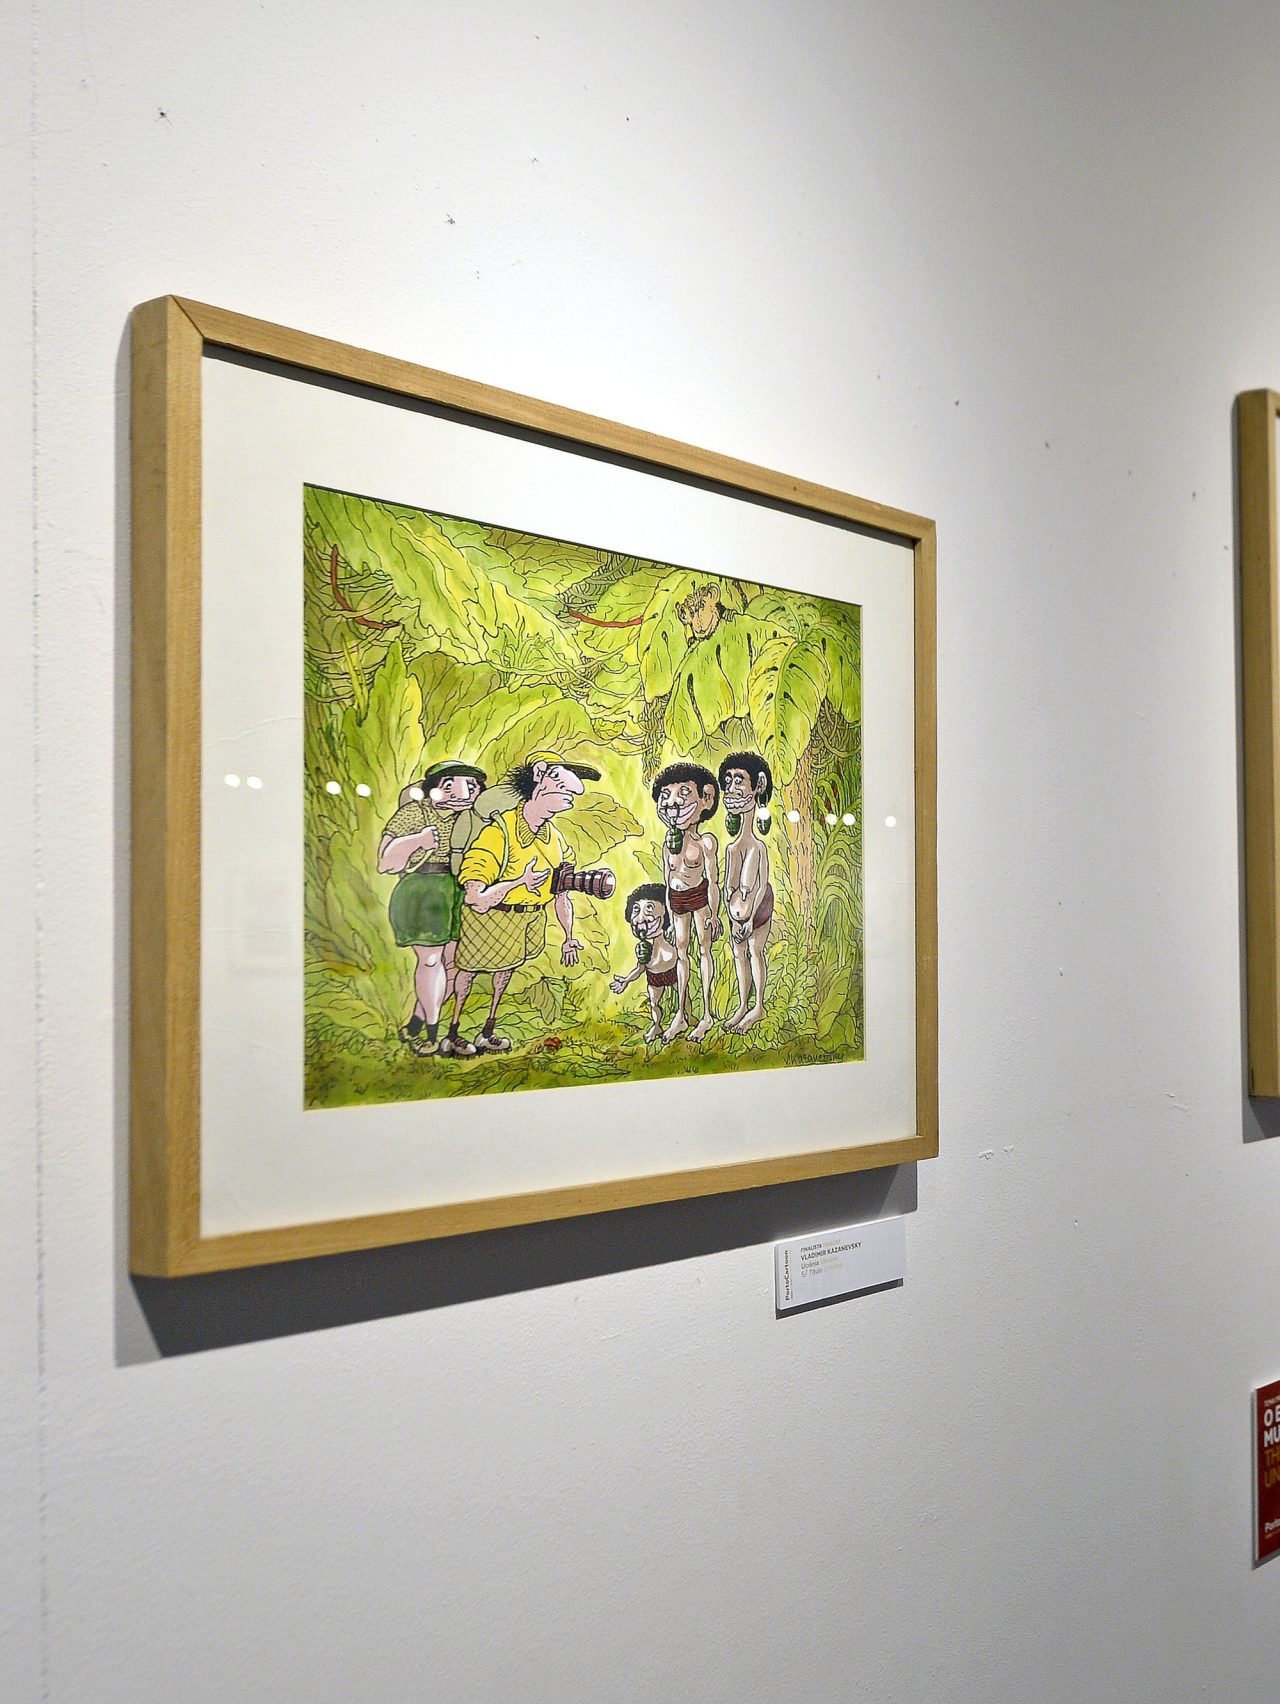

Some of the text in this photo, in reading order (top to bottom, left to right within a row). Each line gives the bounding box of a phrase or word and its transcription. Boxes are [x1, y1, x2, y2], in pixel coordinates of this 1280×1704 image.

[801, 1250, 826, 1261] VLADIMIR
[827, 1242, 861, 1254] KAZANEVSKY
[1263, 1408, 1274, 1427] O
